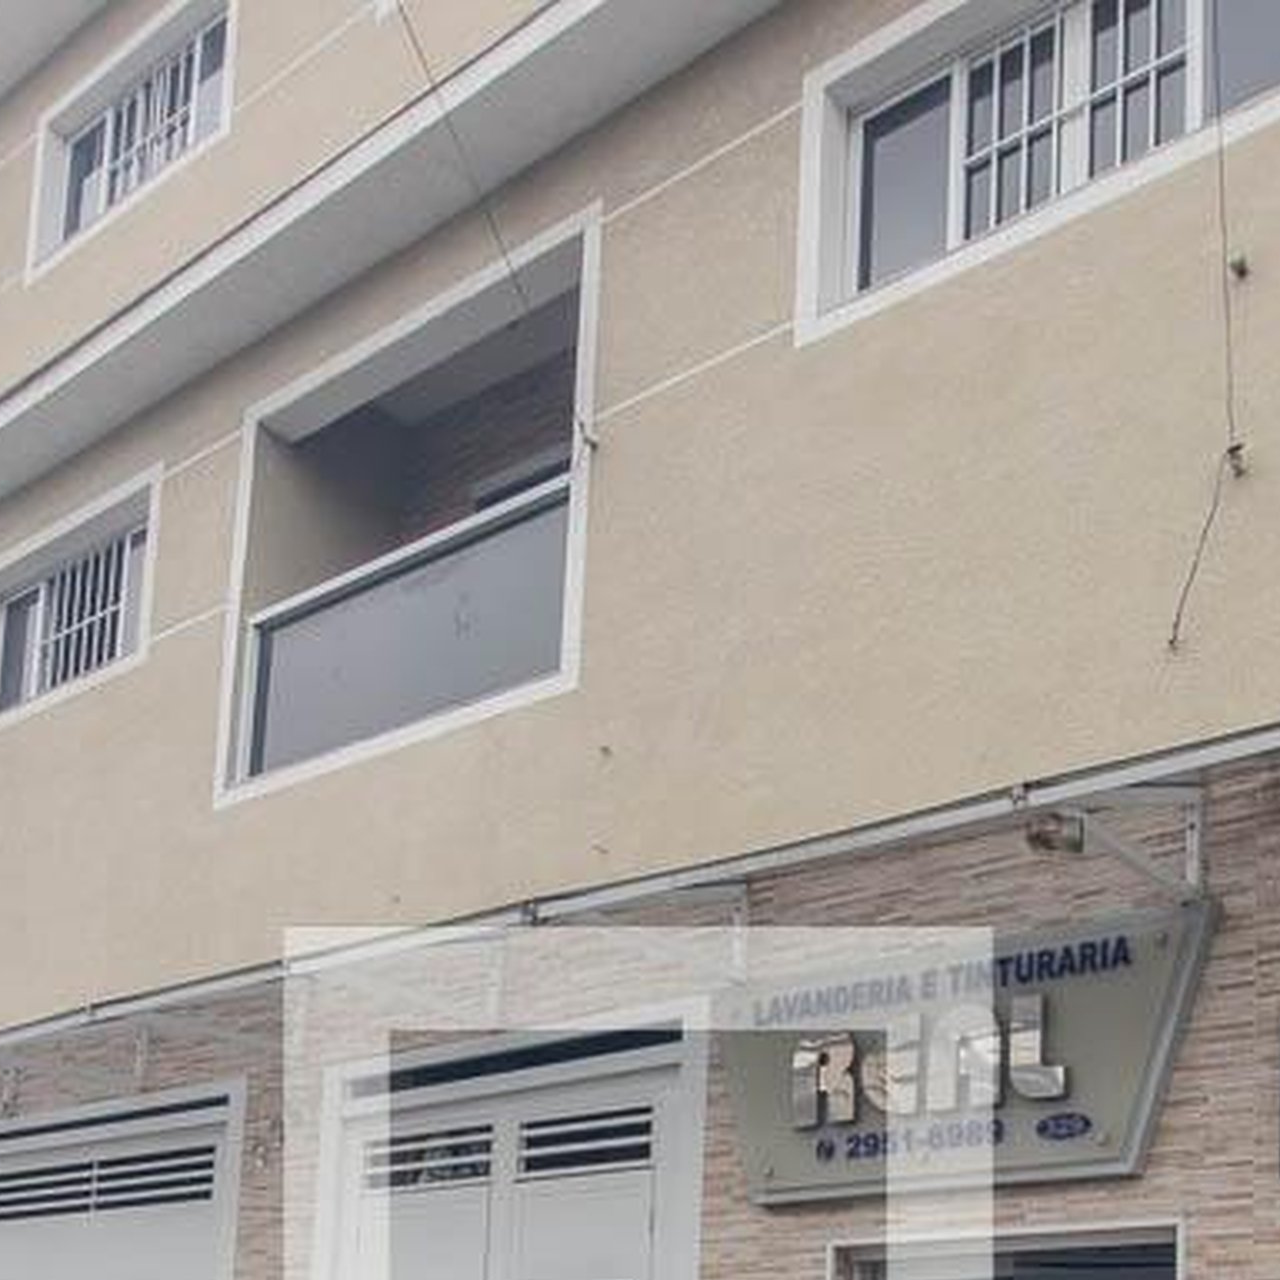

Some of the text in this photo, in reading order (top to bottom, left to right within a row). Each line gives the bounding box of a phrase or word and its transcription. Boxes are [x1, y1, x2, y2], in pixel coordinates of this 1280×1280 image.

[753, 936, 1133, 1027] LAVANDERIA E TINTURARIA
